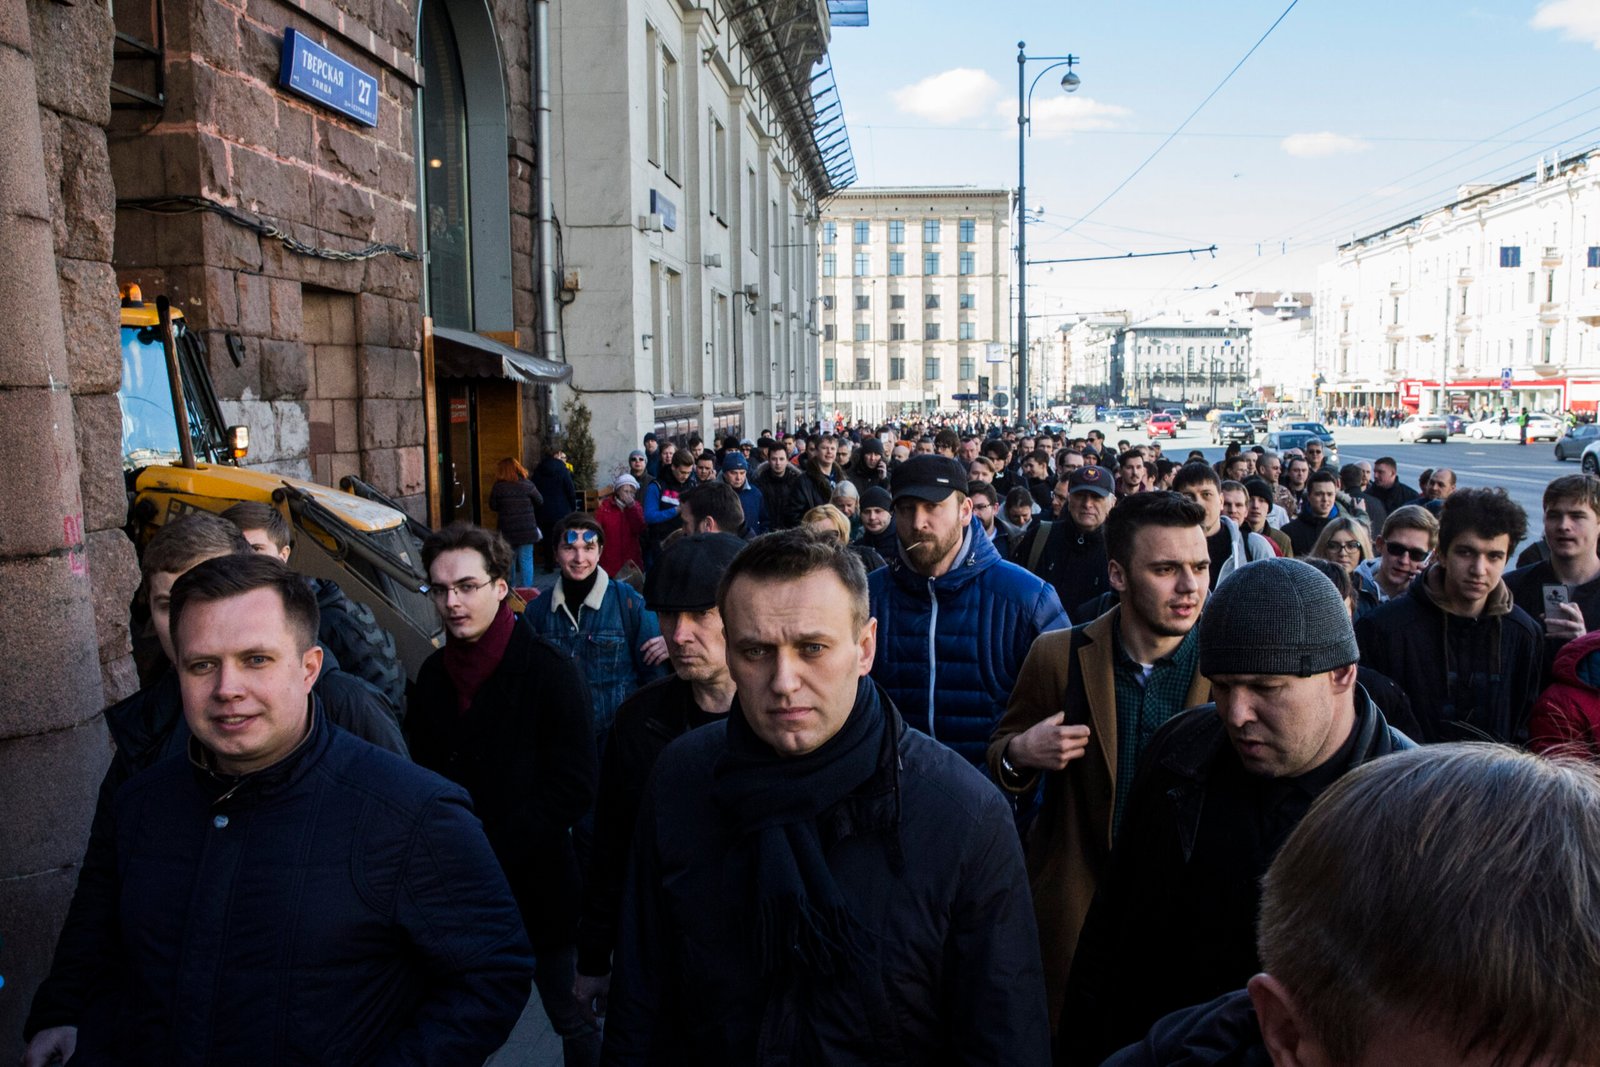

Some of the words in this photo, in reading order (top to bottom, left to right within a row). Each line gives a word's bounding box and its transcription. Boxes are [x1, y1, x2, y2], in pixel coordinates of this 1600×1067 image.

[302, 49, 344, 88] ТВЕРСКАЯ
[312, 77, 332, 95] УЛИЦА
[358, 79, 372, 106] 27
